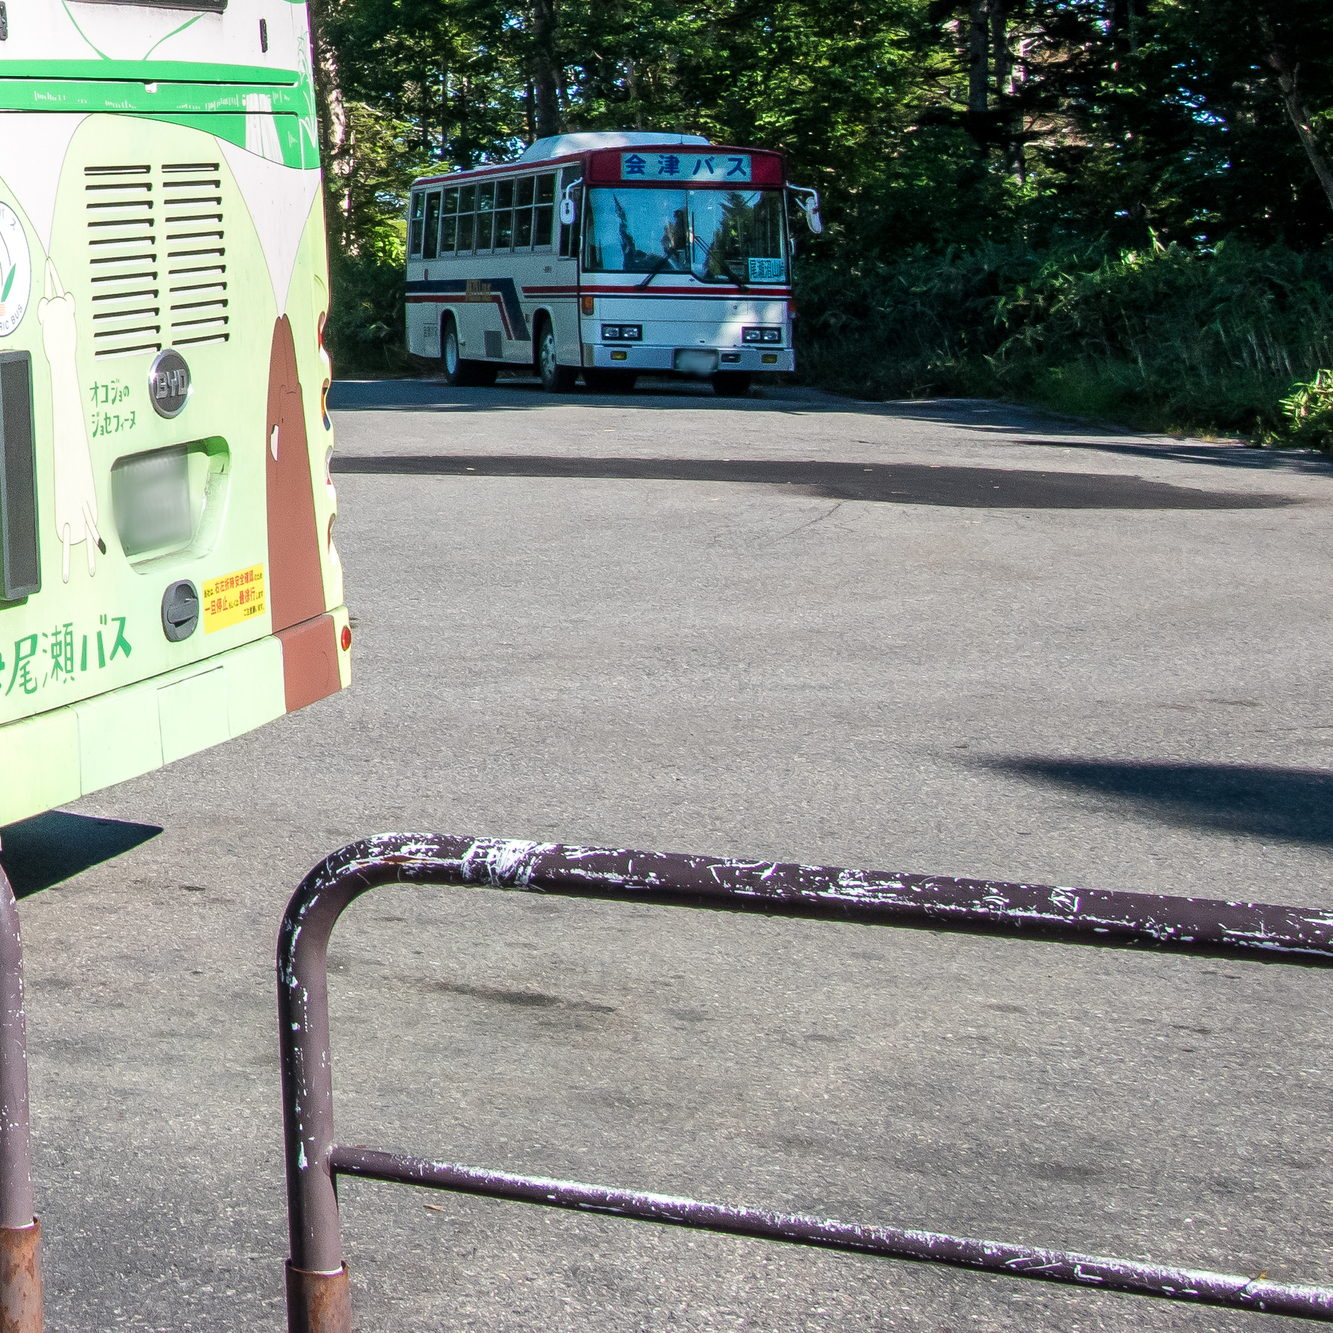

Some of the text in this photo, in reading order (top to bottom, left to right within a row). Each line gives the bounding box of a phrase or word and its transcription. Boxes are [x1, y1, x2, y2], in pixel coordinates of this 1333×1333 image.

[625, 154, 747, 176] 会津バス
[11, 304, 23, 322] BUS
[89, 378, 130, 408] オコジョの
[155, 369, 187, 399] BYD
[92, 411, 136, 438] ジョセフィーヌ
